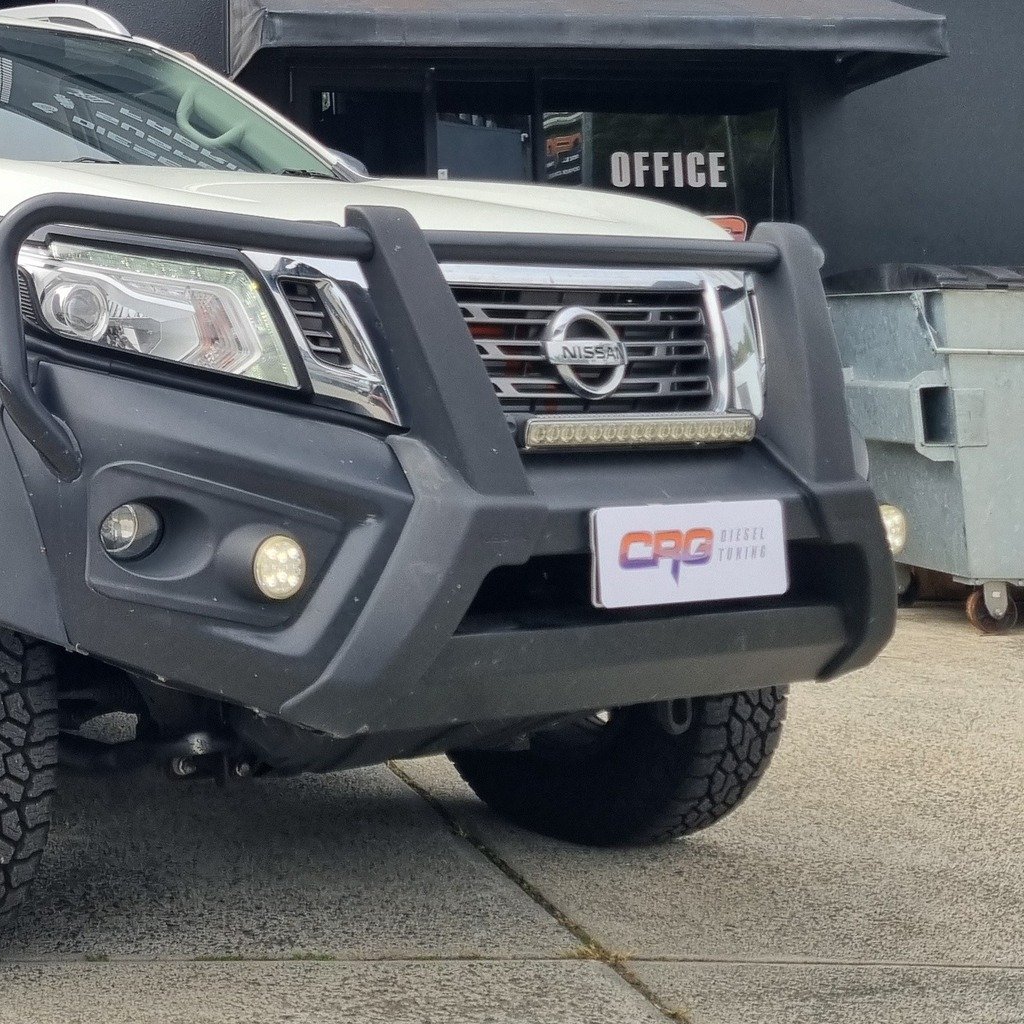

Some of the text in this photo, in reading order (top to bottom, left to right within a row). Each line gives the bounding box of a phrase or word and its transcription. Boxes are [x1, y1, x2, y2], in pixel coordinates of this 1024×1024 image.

[610, 151, 728, 190] OFFICE
[561, 344, 626, 361] NISSAN
[720, 526, 766, 543] DIESEL
[617, 525, 715, 588] CRG
[718, 544, 767, 562] TUNING
